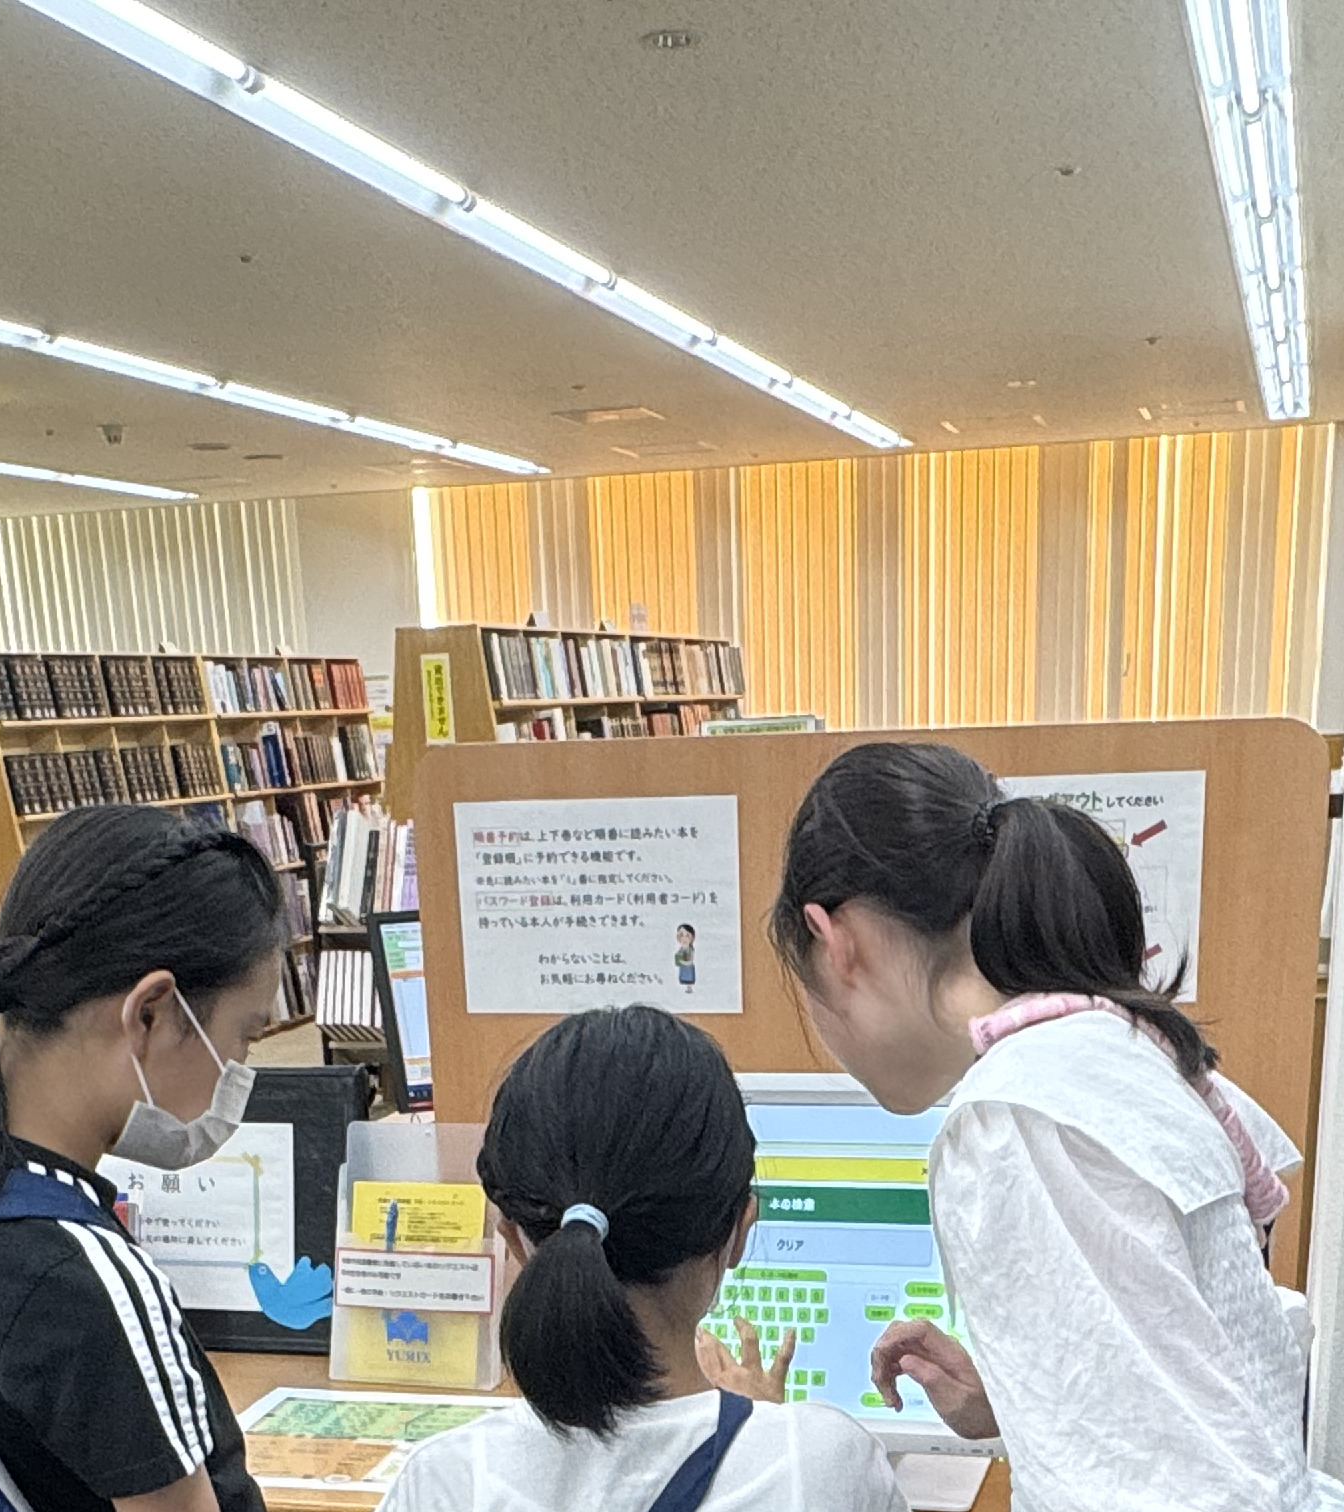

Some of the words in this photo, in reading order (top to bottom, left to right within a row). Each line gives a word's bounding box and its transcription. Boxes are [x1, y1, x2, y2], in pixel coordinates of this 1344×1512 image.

[127, 1172, 216, 1194] お願い
[776, 1238, 804, 1251] クリア
